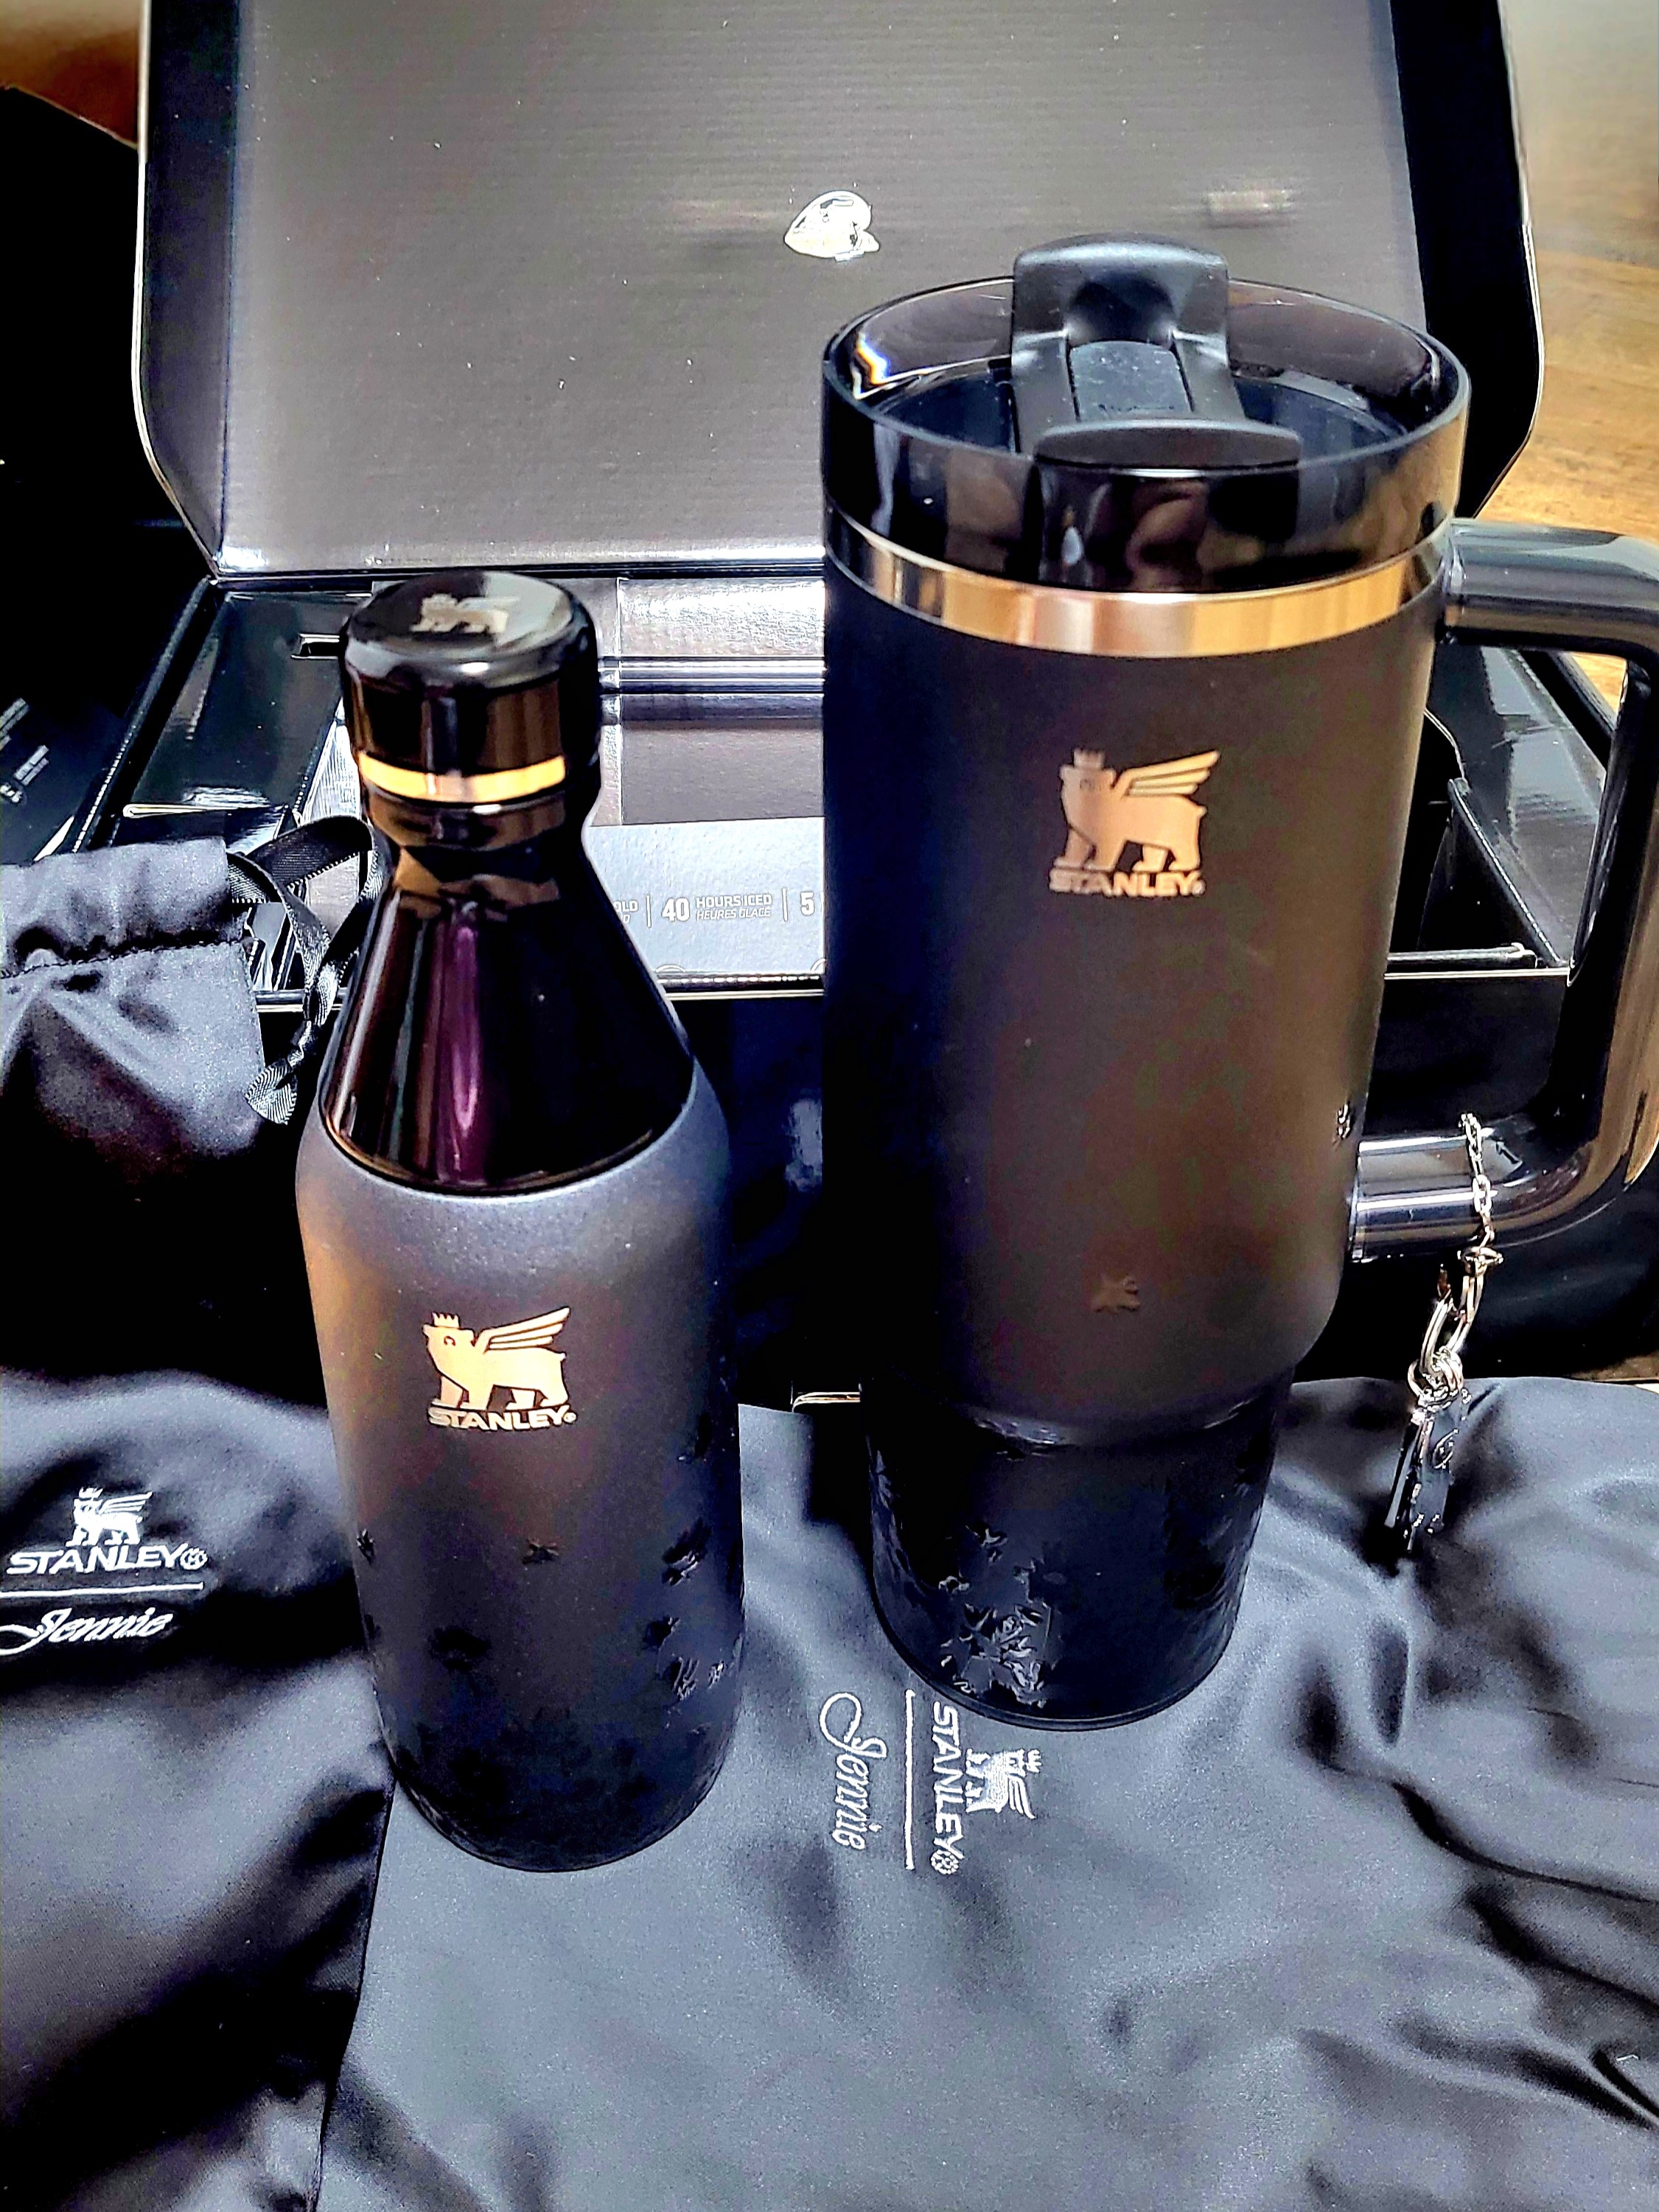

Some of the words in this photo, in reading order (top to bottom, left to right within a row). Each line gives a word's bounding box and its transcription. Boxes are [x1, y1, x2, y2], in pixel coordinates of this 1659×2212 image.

[613, 900, 638, 913] OLD
[696, 895, 741, 909] HOURS
[743, 894, 772, 906] ICED
[662, 897, 690, 922] 40
[696, 909, 737, 921] HEURES
[820, 1692, 887, 1849] Jennie
